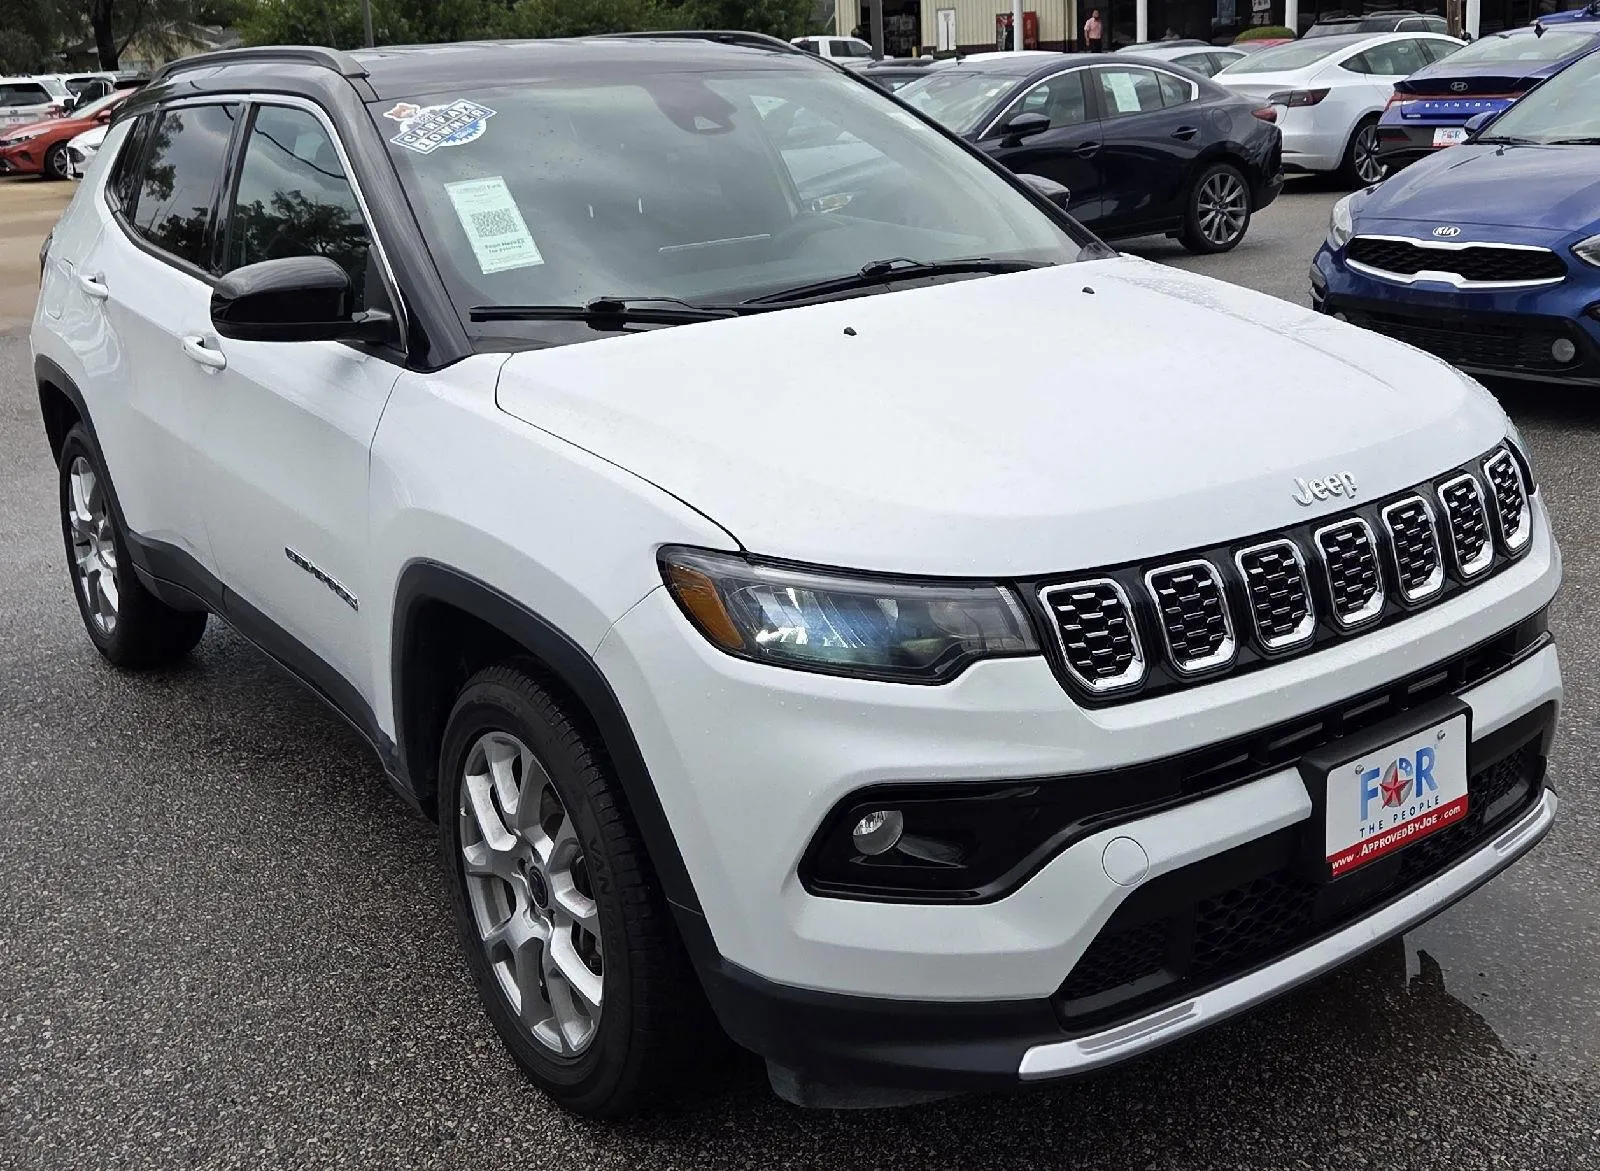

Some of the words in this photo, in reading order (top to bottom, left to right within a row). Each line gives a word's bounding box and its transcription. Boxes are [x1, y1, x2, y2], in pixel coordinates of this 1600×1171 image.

[402, 104, 474, 143] CARFAX
[429, 109, 484, 140] OWNER
[1434, 226, 1458, 236] KIA
[1292, 471, 1357, 507] Jeep
[1360, 820, 1384, 838] THE
[1394, 795, 1440, 824] PEOPLE
